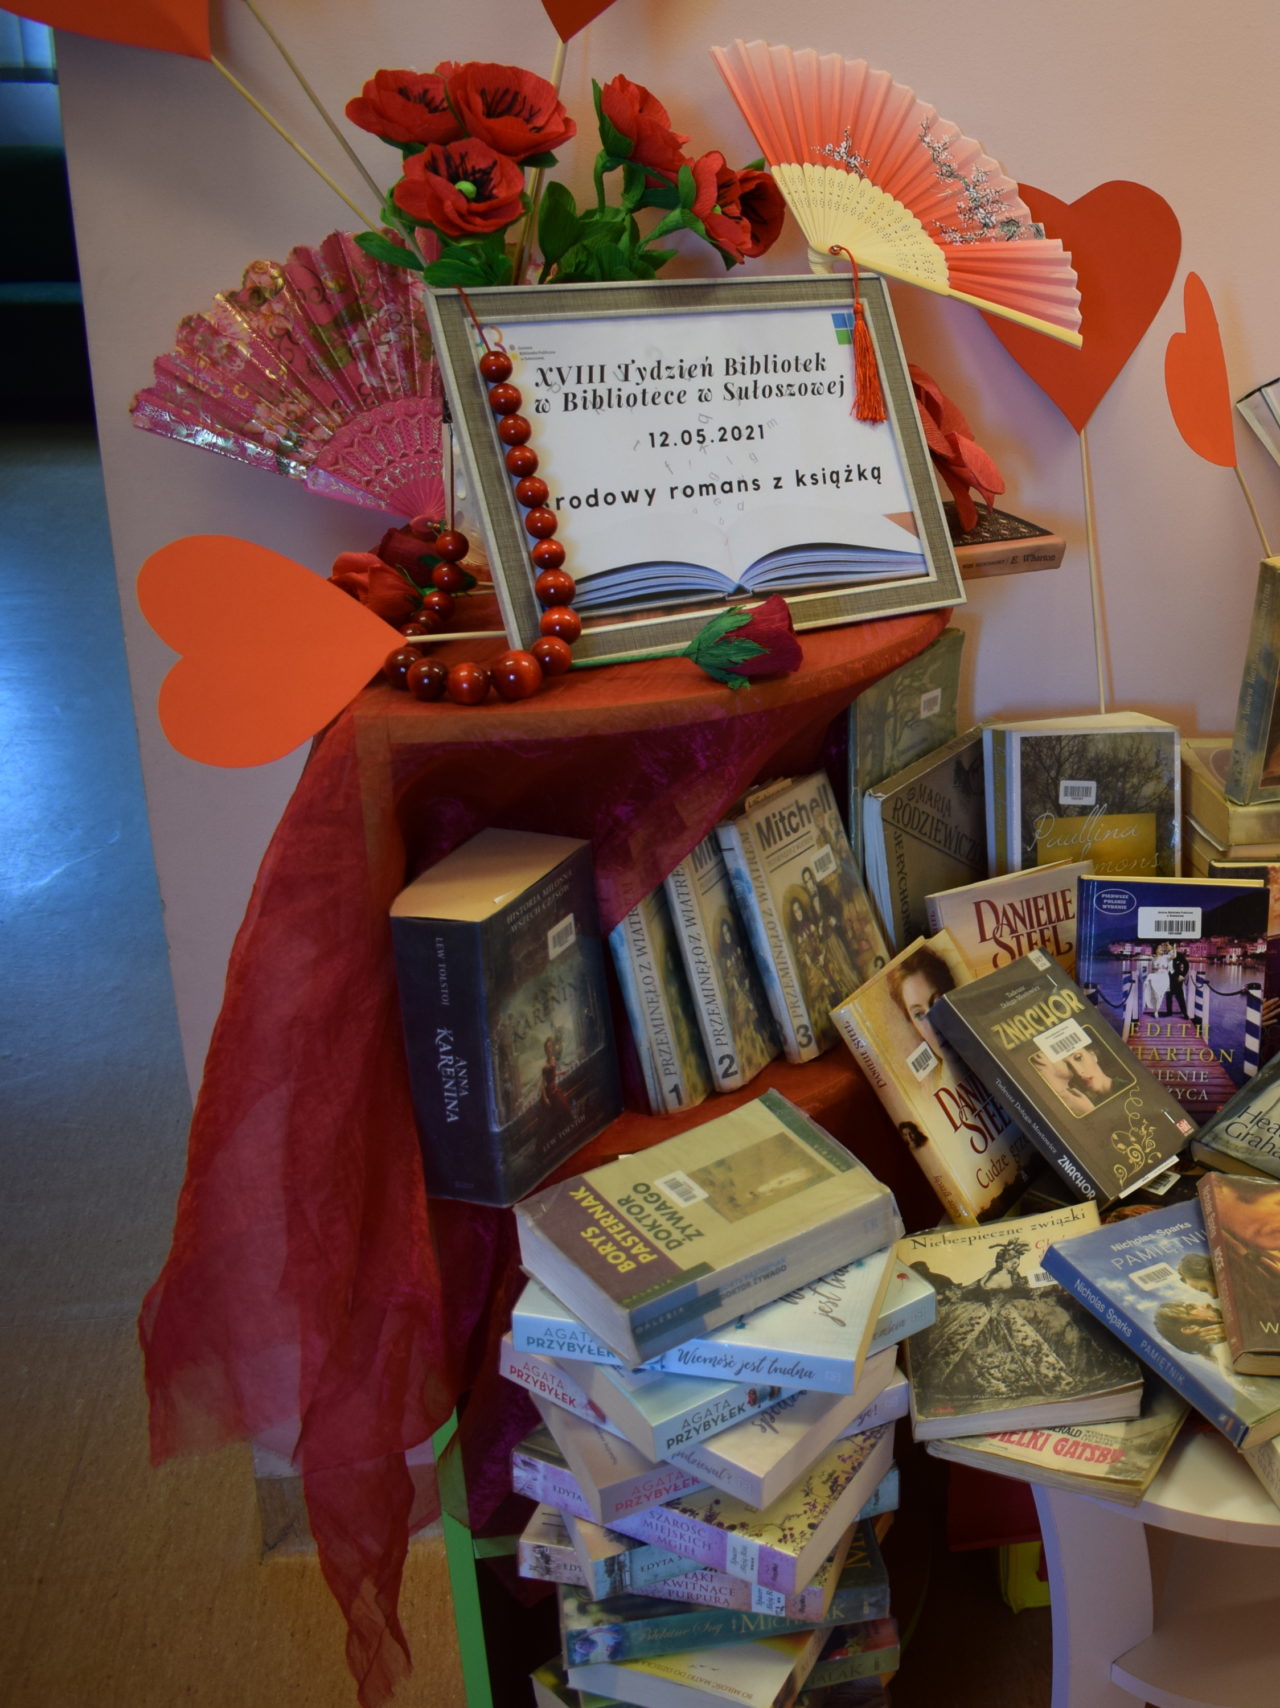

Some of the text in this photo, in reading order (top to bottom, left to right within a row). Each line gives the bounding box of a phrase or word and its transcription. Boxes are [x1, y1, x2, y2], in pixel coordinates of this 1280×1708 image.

[535, 352, 827, 388] XVIII Tydzień Bibliotek
[535, 374, 845, 413] w Bibliotece w Sułoszowej
[648, 424, 766, 448] 12.05.2021
[543, 464, 883, 511] rodowy romans z książką
[755, 783, 832, 851] Mitchell
[892, 797, 980, 864] RODZIEWICZ
[1026, 803, 1138, 852] Paullina
[972, 888, 1076, 944] DANIELLE
[435, 936, 446, 960] LEW
[992, 925, 1074, 969] STEEL
[639, 960, 652, 975] Z
[671, 864, 738, 1079] PRZEMINĘŁO Z WIATRE 2
[641, 975, 678, 1076] PRZEMINĘŁO
[796, 1024, 813, 1049] 3
[843, 1020, 867, 1050] STEEL
[990, 988, 1086, 1051] ZNACHOR
[1130, 1022, 1211, 1038] EDITH
[435, 1026, 460, 1124] KARENINA
[454, 1056, 470, 1097] ANNA
[861, 1050, 888, 1089] DANIELLE
[668, 1082, 684, 1106] 1
[976, 1153, 1009, 1189] Cudze
[1057, 1154, 1096, 1200] ZNACHOR
[568, 1186, 658, 1264] PASTERNAK
[617, 1194, 684, 1251] DOKTOR
[632, 1182, 705, 1242] ŻYWAGO
[911, 1226, 1024, 1249] Niebezpieczne
[1031, 1208, 1087, 1231] związki
[580, 1226, 637, 1273] BORYS
[1110, 1221, 1193, 1252] Nicholas Sparks
[1074, 1279, 1105, 1313] Nicholas
[1105, 1308, 1133, 1337] Sparks
[1259, 1320, 1279, 1335] W
[527, 1336, 616, 1359] PRZYBYŁEK
[677, 1348, 816, 1379] Wierność jest trudna
[510, 1364, 577, 1409] PRZYBYŁEK
[522, 1361, 565, 1389] AGATA
[665, 1402, 747, 1450] PRZYBYŁEK
[681, 1399, 732, 1431] AGATA
[985, 1428, 1052, 1452] IELKI
[1052, 1436, 1125, 1464] GATSBY
[552, 1485, 583, 1501] EDYTA
[614, 1475, 700, 1513] PRZYBYŁEK
[631, 1470, 685, 1496] AGATA
[642, 1518, 713, 1552] MIEJSKICH
[648, 1508, 707, 1538] SZAROŚĆ
[640, 1558, 675, 1573] EDYTA
